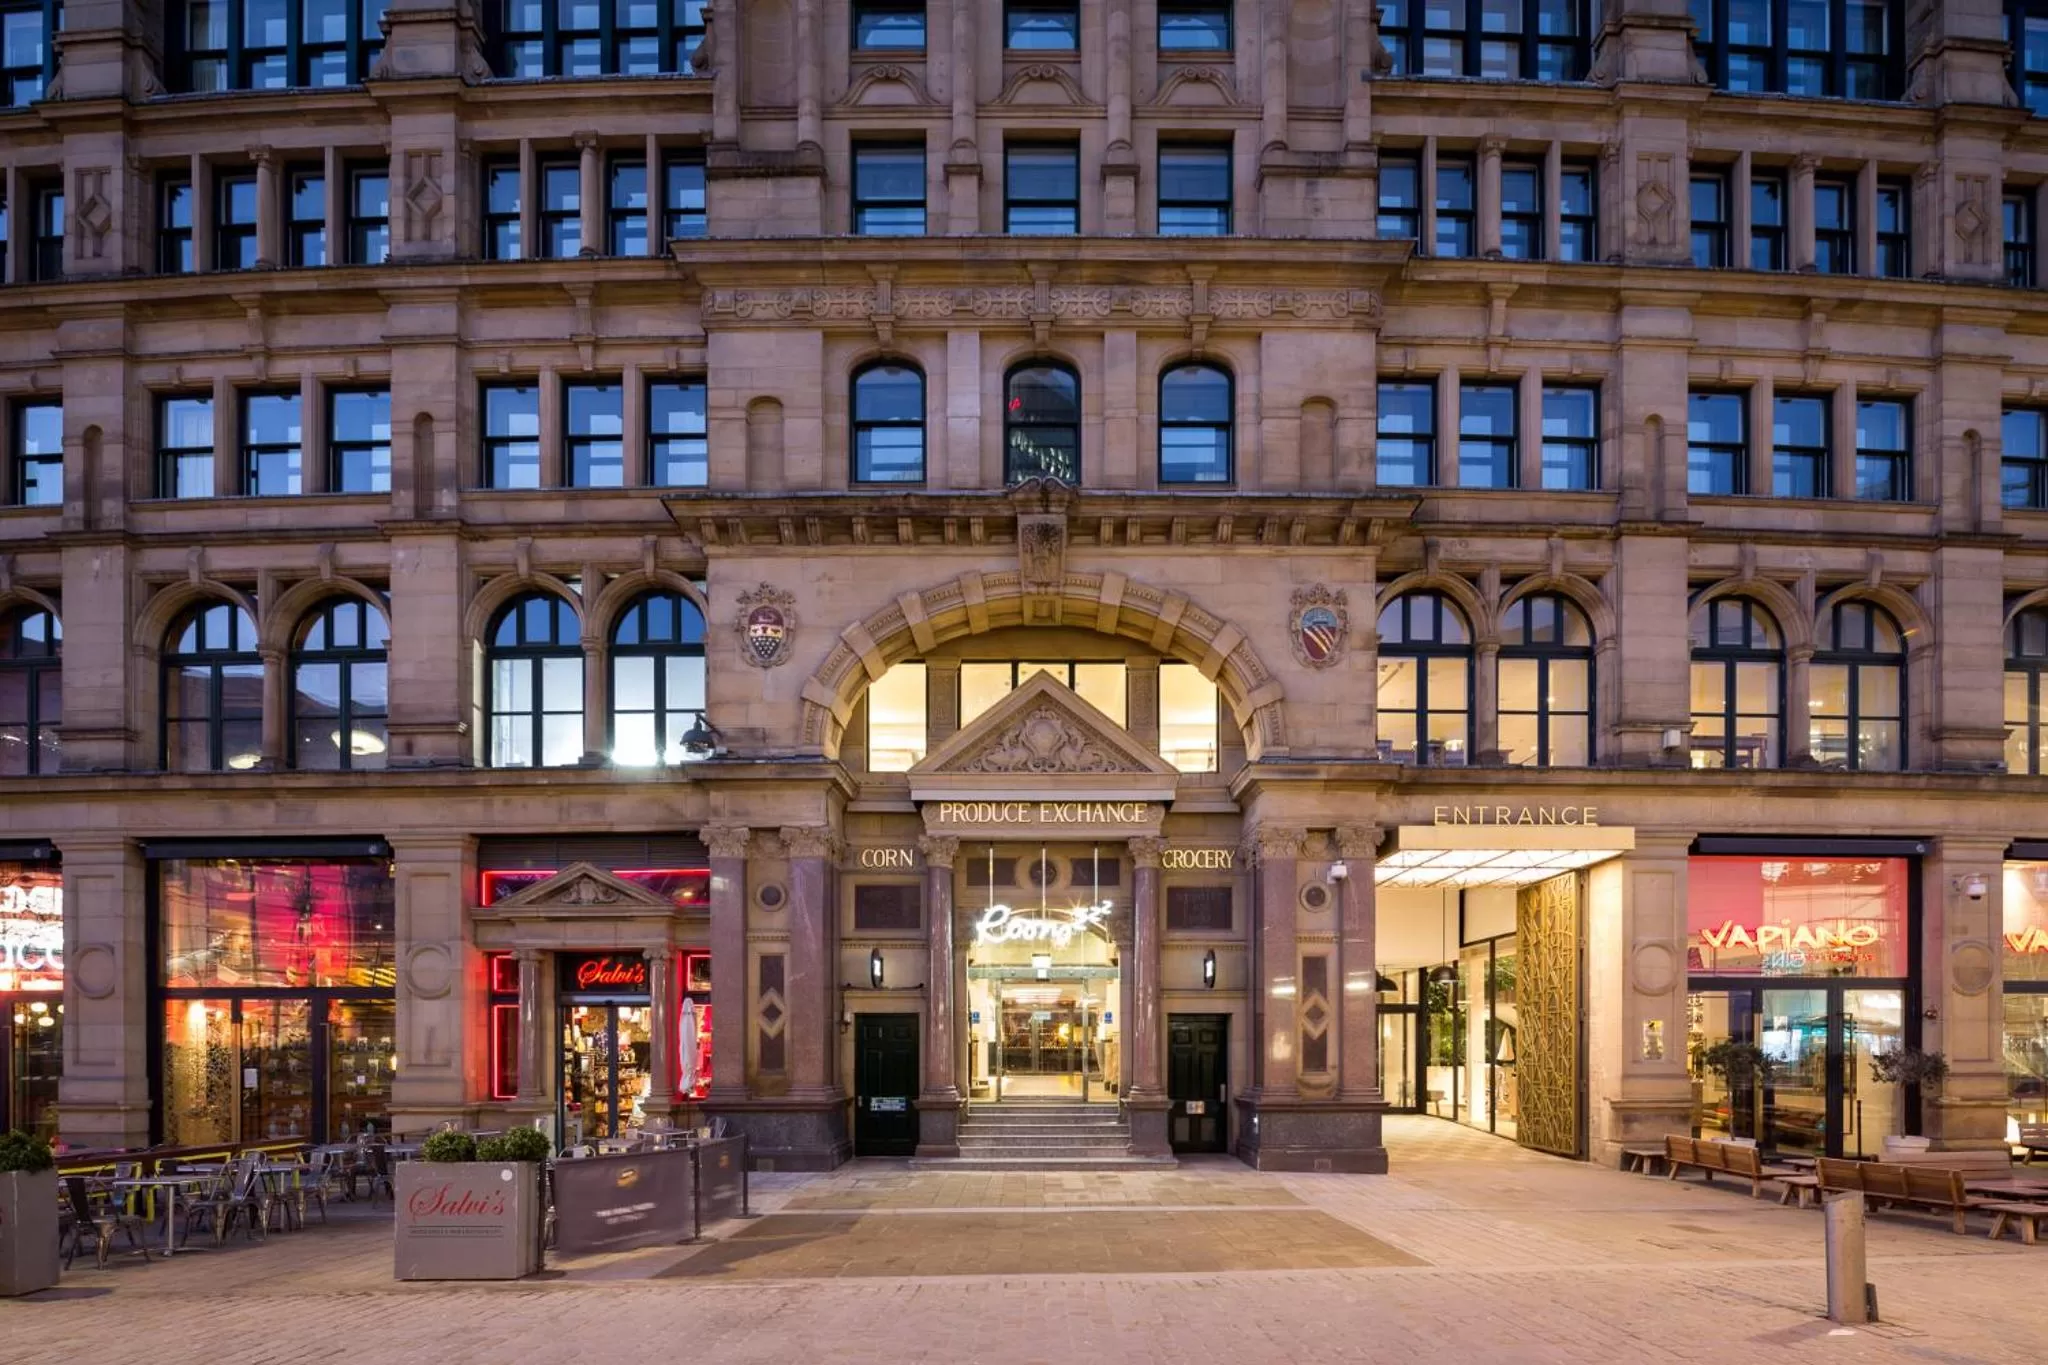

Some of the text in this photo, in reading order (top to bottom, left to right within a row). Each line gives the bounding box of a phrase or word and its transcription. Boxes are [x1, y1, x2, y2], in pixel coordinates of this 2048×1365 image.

[939, 802, 1148, 823] PRODUCE EXCHANGE
[1434, 806, 1599, 826] ENTRANCE
[861, 848, 914, 868] CORN
[1161, 849, 1235, 869] GROCERY
[577, 958, 645, 990] Salvi's
[407, 1182, 506, 1224] Salvi's
